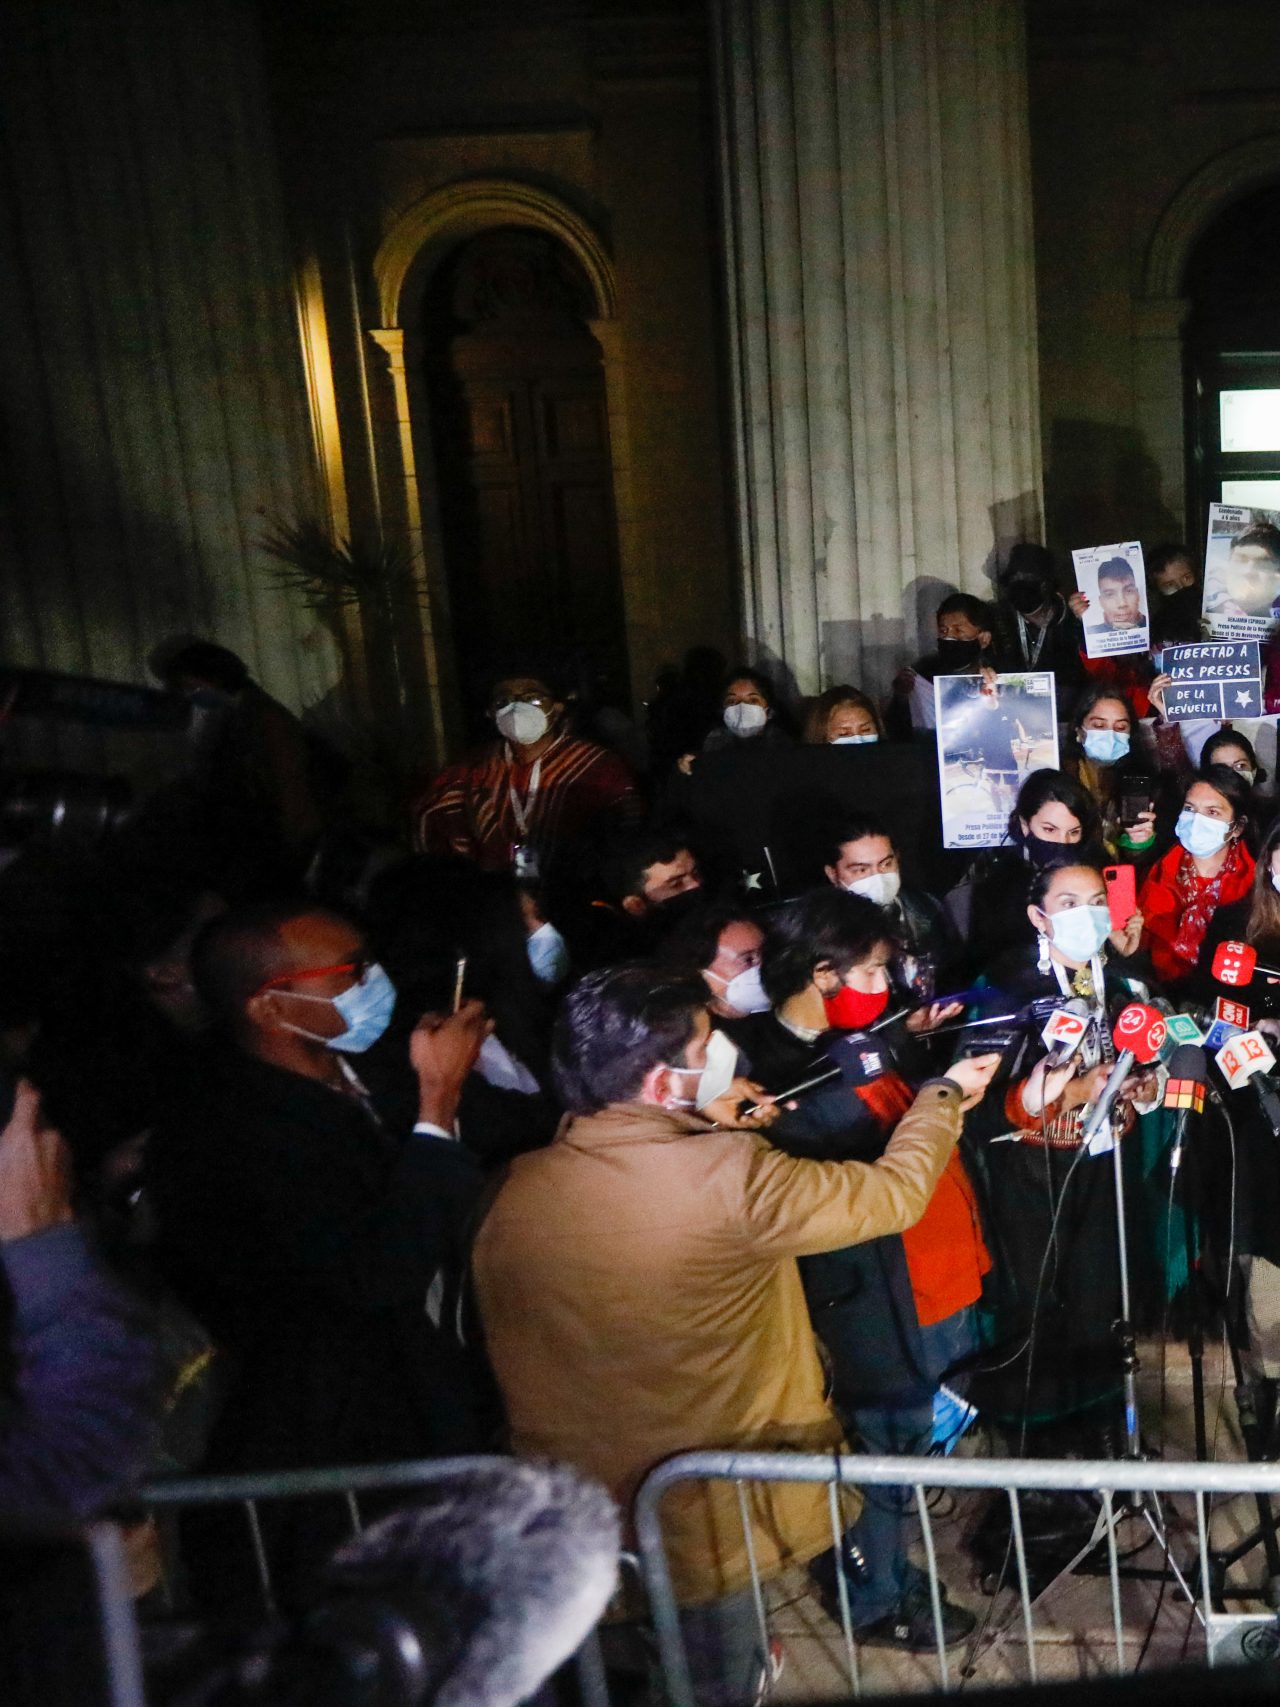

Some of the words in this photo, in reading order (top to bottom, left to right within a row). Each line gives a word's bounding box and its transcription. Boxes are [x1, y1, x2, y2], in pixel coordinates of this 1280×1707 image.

[1173, 646, 1235, 661] LIBERTAD
[1239, 644, 1248, 657] A
[1170, 666, 1194, 679] LXS
[1199, 663, 1251, 678] PRESXS
[1176, 690, 1190, 700] DE
[1194, 689, 1205, 699] LA
[1167, 703, 1218, 716] REVUELTA
[1122, 1012, 1141, 1026] 24
[1151, 1028, 1163, 1045] 24
[1240, 1038, 1265, 1061] 13
[1222, 1050, 1242, 1078] 13
